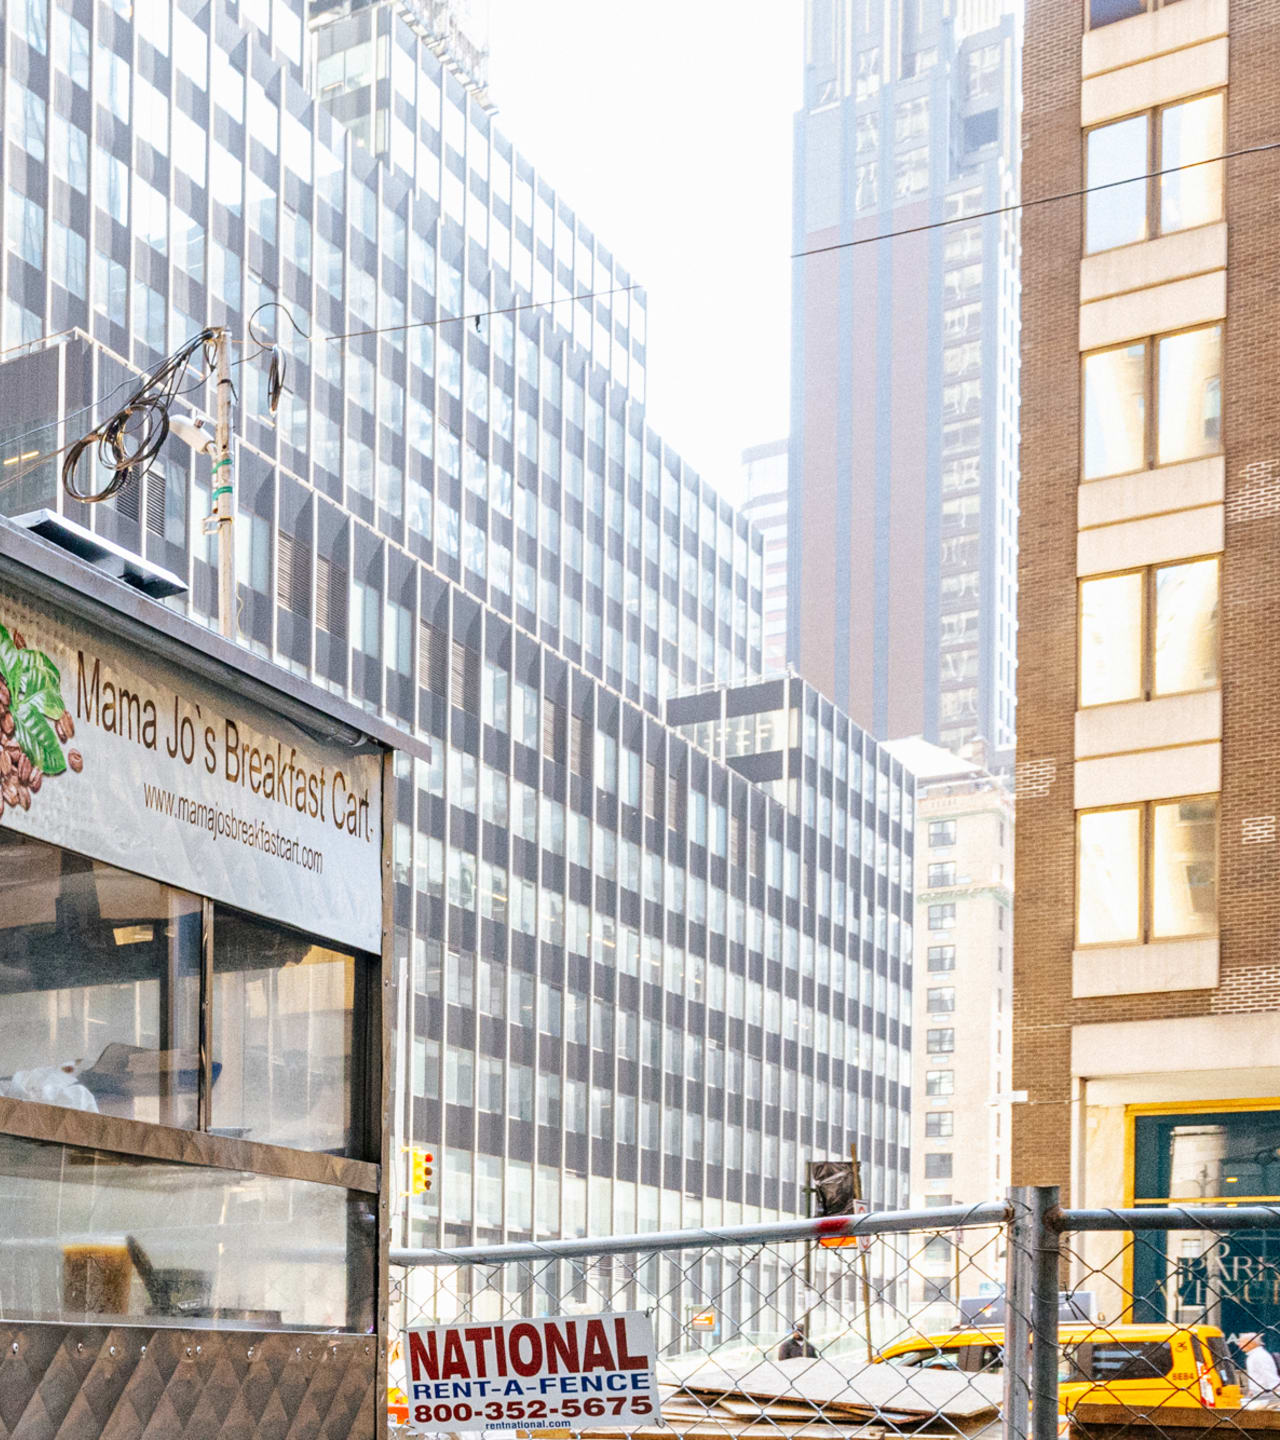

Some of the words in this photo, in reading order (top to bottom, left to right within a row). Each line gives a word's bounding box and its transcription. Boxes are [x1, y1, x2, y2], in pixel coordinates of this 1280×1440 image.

[76, 650, 157, 750] Mama
[225, 719, 325, 822] Breakfast
[333, 771, 370, 842] Cart
[144, 783, 323, 873] www.mamajosbreakfastcart.com
[408, 1318, 649, 1382] NATIONAL
[413, 1373, 651, 1400] RENT-A-FENCE
[414, 1396, 653, 1423] 800-352-5675
[485, 1419, 572, 1430] rentnational.com
